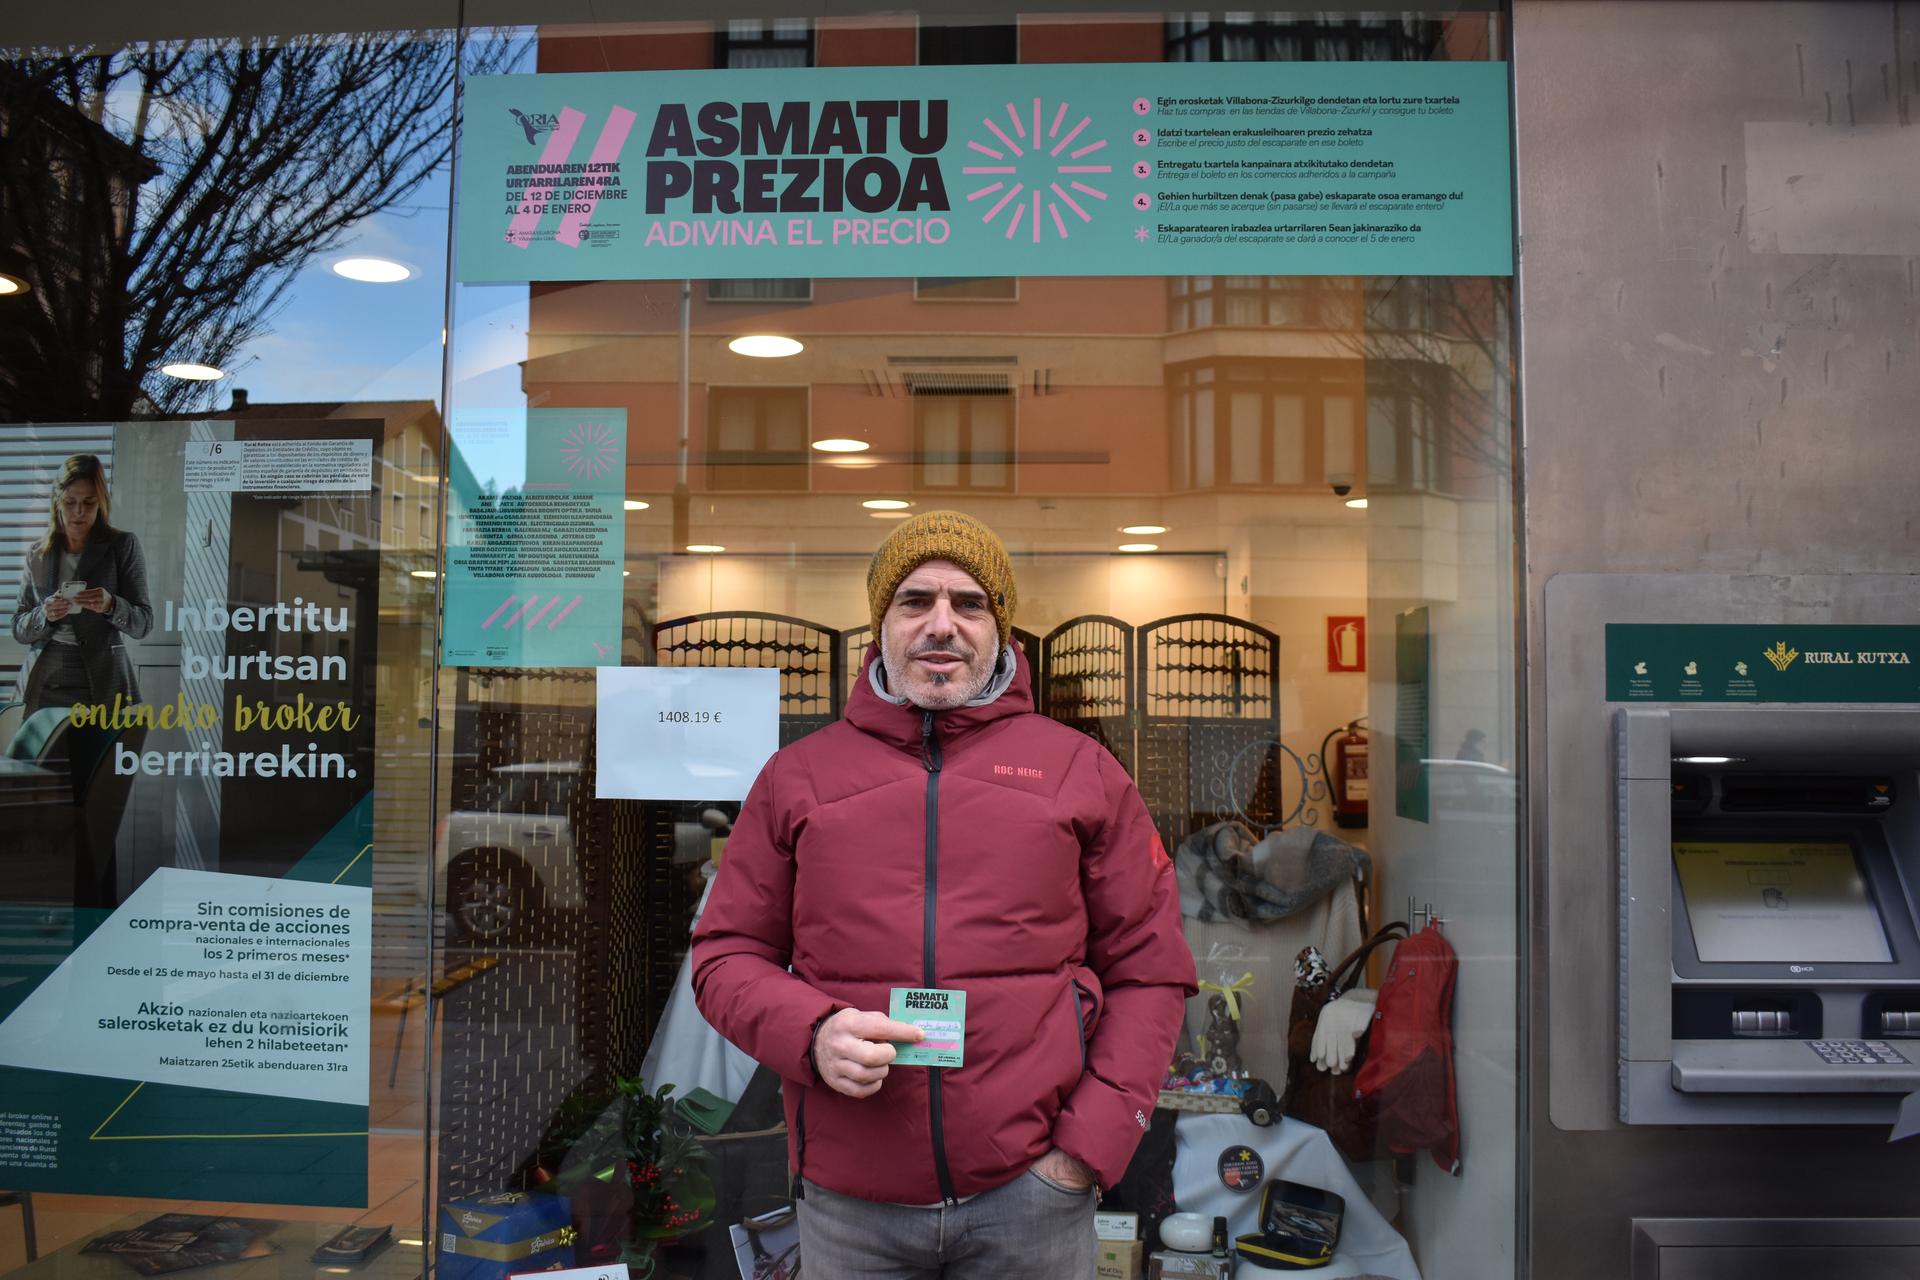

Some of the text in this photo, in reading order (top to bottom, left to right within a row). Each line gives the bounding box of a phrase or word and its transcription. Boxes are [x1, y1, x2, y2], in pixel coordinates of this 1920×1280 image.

[1157, 96, 1176, 107] Egin
[1178, 96, 1224, 105] erosketak
[1225, 96, 1316, 106] Villabona-Zizurkilgo
[1317, 95, 1360, 104] dendetan
[1362, 96, 1377, 104] eta
[1378, 96, 1401, 104] lortu
[1424, 96, 1460, 104] txartela
[646, 100, 948, 156] ASMATU
[1157, 128, 1182, 136] Idatzi
[1232, 127, 1305, 136] erakusleihoaren
[1307, 127, 1336, 137] prezio
[507, 162, 620, 174] ABENDUAREN 12TIK
[1157, 159, 1393, 170] Entregatu txartela kanpainara atxikitutako dendetan
[506, 175, 620, 188] URTARRILAREN 4RA
[646, 157, 951, 214] PREZIOA
[506, 189, 627, 201] DEL 12 DE DICIEMBRE
[1157, 191, 1190, 200] Gehien
[1192, 191, 1238, 200] hurbiltzen
[1239, 191, 1268, 200] denak
[1270, 191, 1296, 201] (pasa
[1297, 191, 1323, 201] gabe)
[1325, 192, 1376, 200] eskaparate
[1401, 193, 1447, 202] eramango
[1448, 191, 1463, 200] du!
[504, 203, 591, 214] AL 4 DE ENERO
[644, 221, 777, 247] ADIVINA
[787, 220, 822, 246] EL
[833, 218, 950, 246] PRECIO
[1157, 223, 1421, 232] Eskaparatearen irabazlea urtarrilaren 5ean jakinaraziko da
[164, 597, 348, 632] Inbertitu
[183, 646, 347, 681] burtsan
[1804, 652, 1910, 664] RURAL KUTXA
[69, 692, 360, 733] onlineko broker
[658, 711, 722, 723] 1408.19 €
[115, 742, 357, 779] berriarekin.
[994, 765, 1043, 778] ROC NEIGE
[197, 901, 350, 918] Sin comisiones de
[129, 918, 350, 934] compra-venta de acciones
[195, 935, 253, 944] nacionales
[265, 937, 350, 947] internacionales
[203, 948, 222, 959] los
[225, 948, 233, 959] 2
[237, 950, 298, 962] primeros
[107, 966, 349, 982] Desde el 25 de mayo hasta el 31 de diciembre
[906, 992, 948, 1001] ASMATU
[137, 1001, 184, 1016] Akzio
[905, 1001, 948, 1009] PREZIOA
[188, 1007, 348, 1021] nazionalen eta nazioartekoen
[98, 1016, 348, 1037] salerosketak ez du komisiorik
[205, 1037, 242, 1048] lehen
[246, 1038, 254, 1049] 2
[159, 1056, 348, 1071] Maiatzaren 25etik abenduaren 31ra
